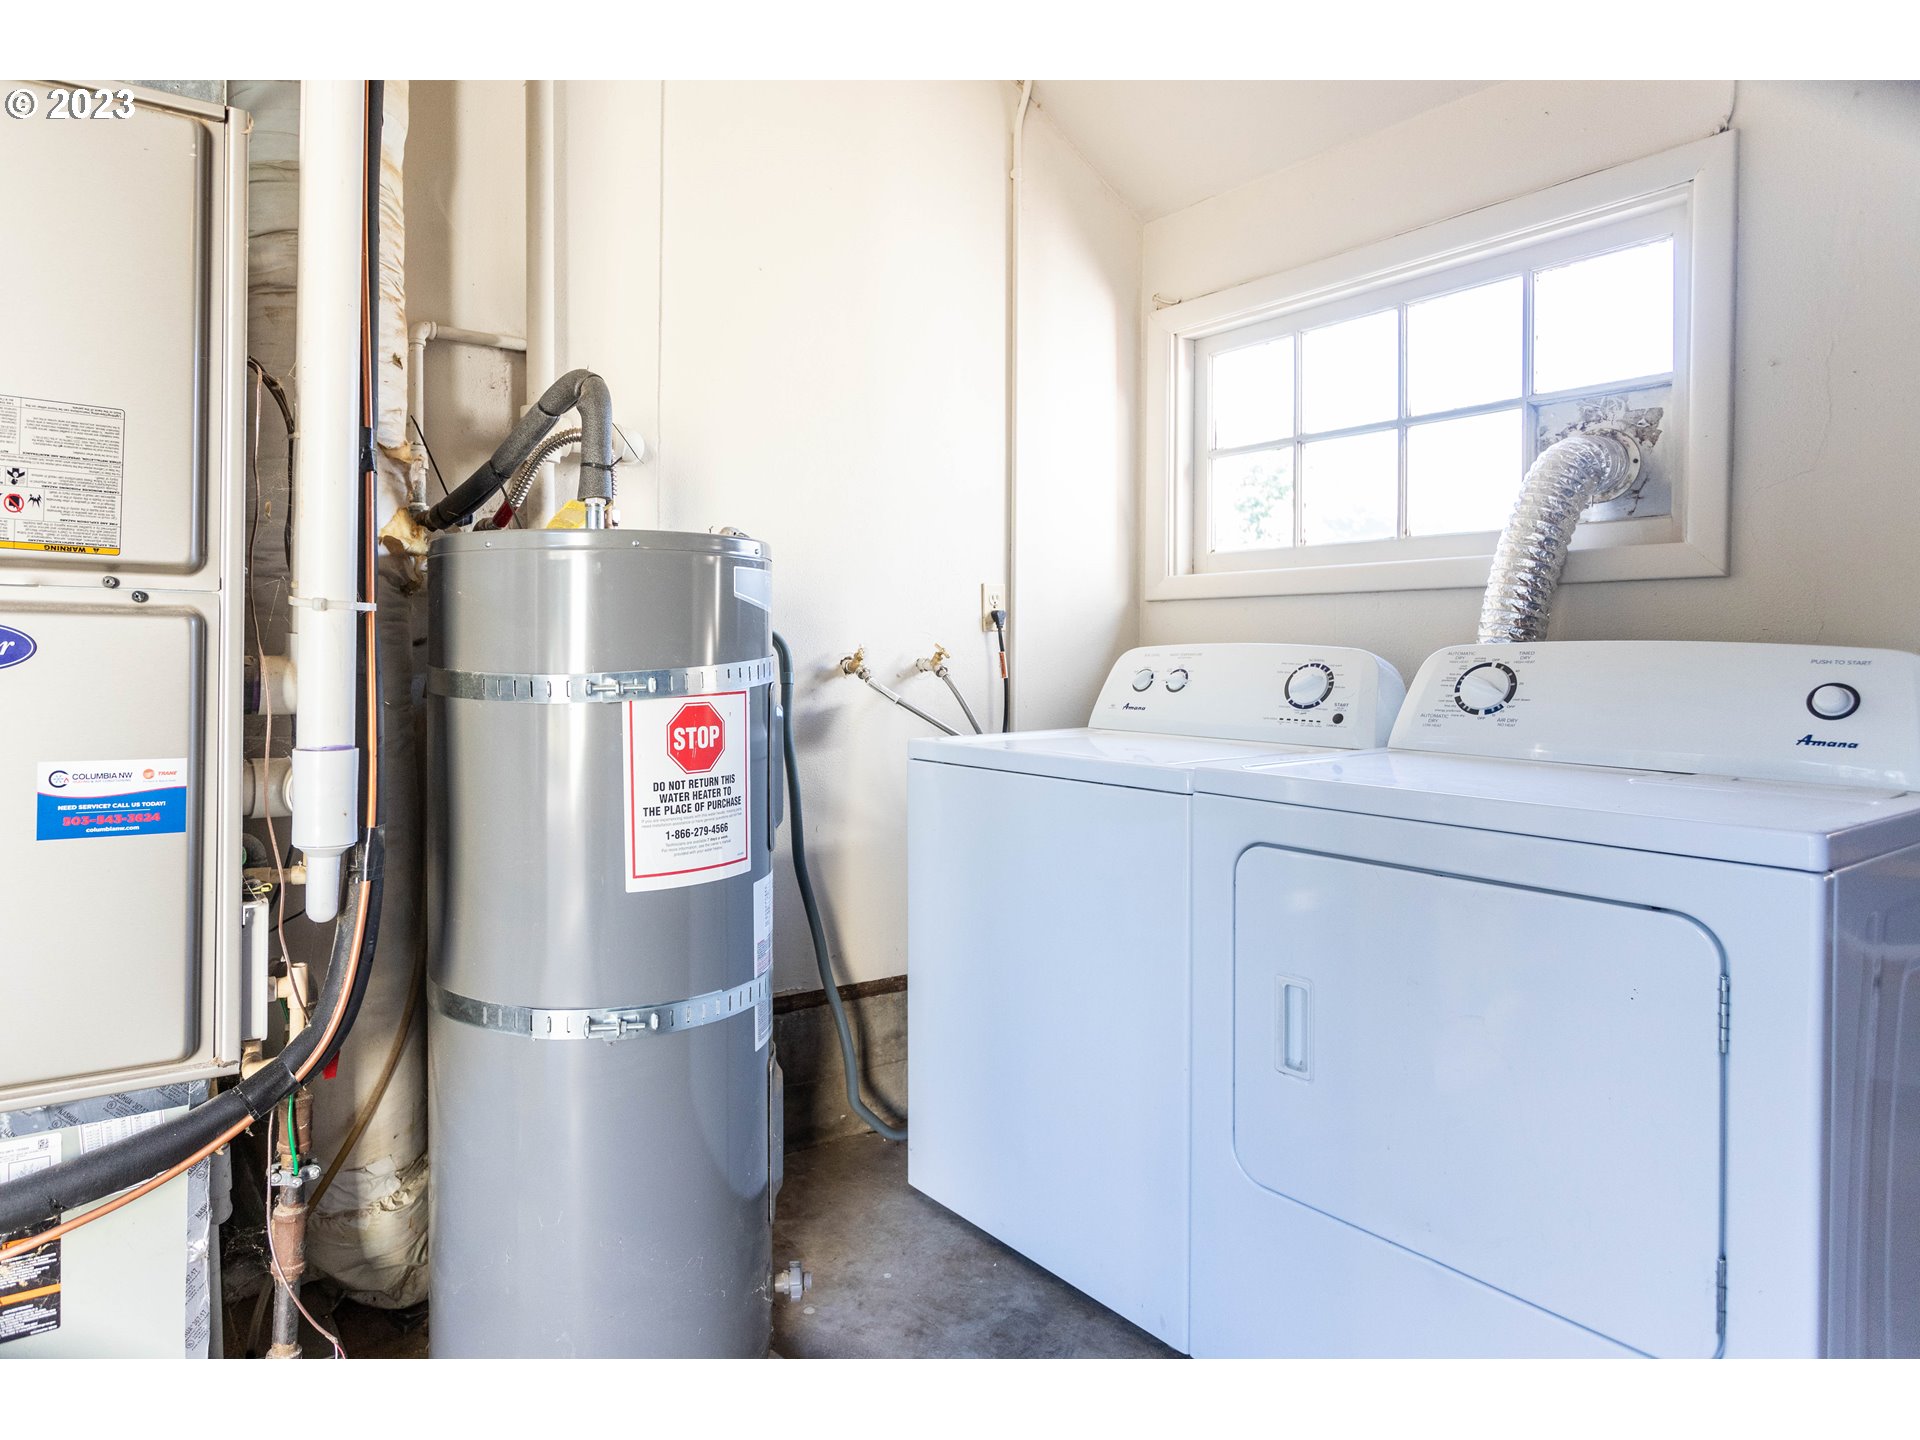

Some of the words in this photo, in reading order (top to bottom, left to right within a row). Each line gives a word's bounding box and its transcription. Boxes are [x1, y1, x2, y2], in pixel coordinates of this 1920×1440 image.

[673, 725, 720, 751] STOP
[1795, 734, 1860, 749] Amana
[72, 773, 117, 781] COLUMBIA
[653, 782, 666, 792] DO
[668, 780, 686, 791] NOT
[689, 776, 719, 789] RETURN
[721, 774, 736, 785] THIS
[659, 793, 690, 803] WATER
[693, 789, 721, 800] HEATER
[723, 786, 731, 796] TO
[643, 807, 660, 817] THE
[664, 804, 692, 815] PLACE
[695, 803, 704, 812] OF
[707, 796, 741, 810] PURCHASE
[666, 823, 728, 840] 1-866-279-4566
